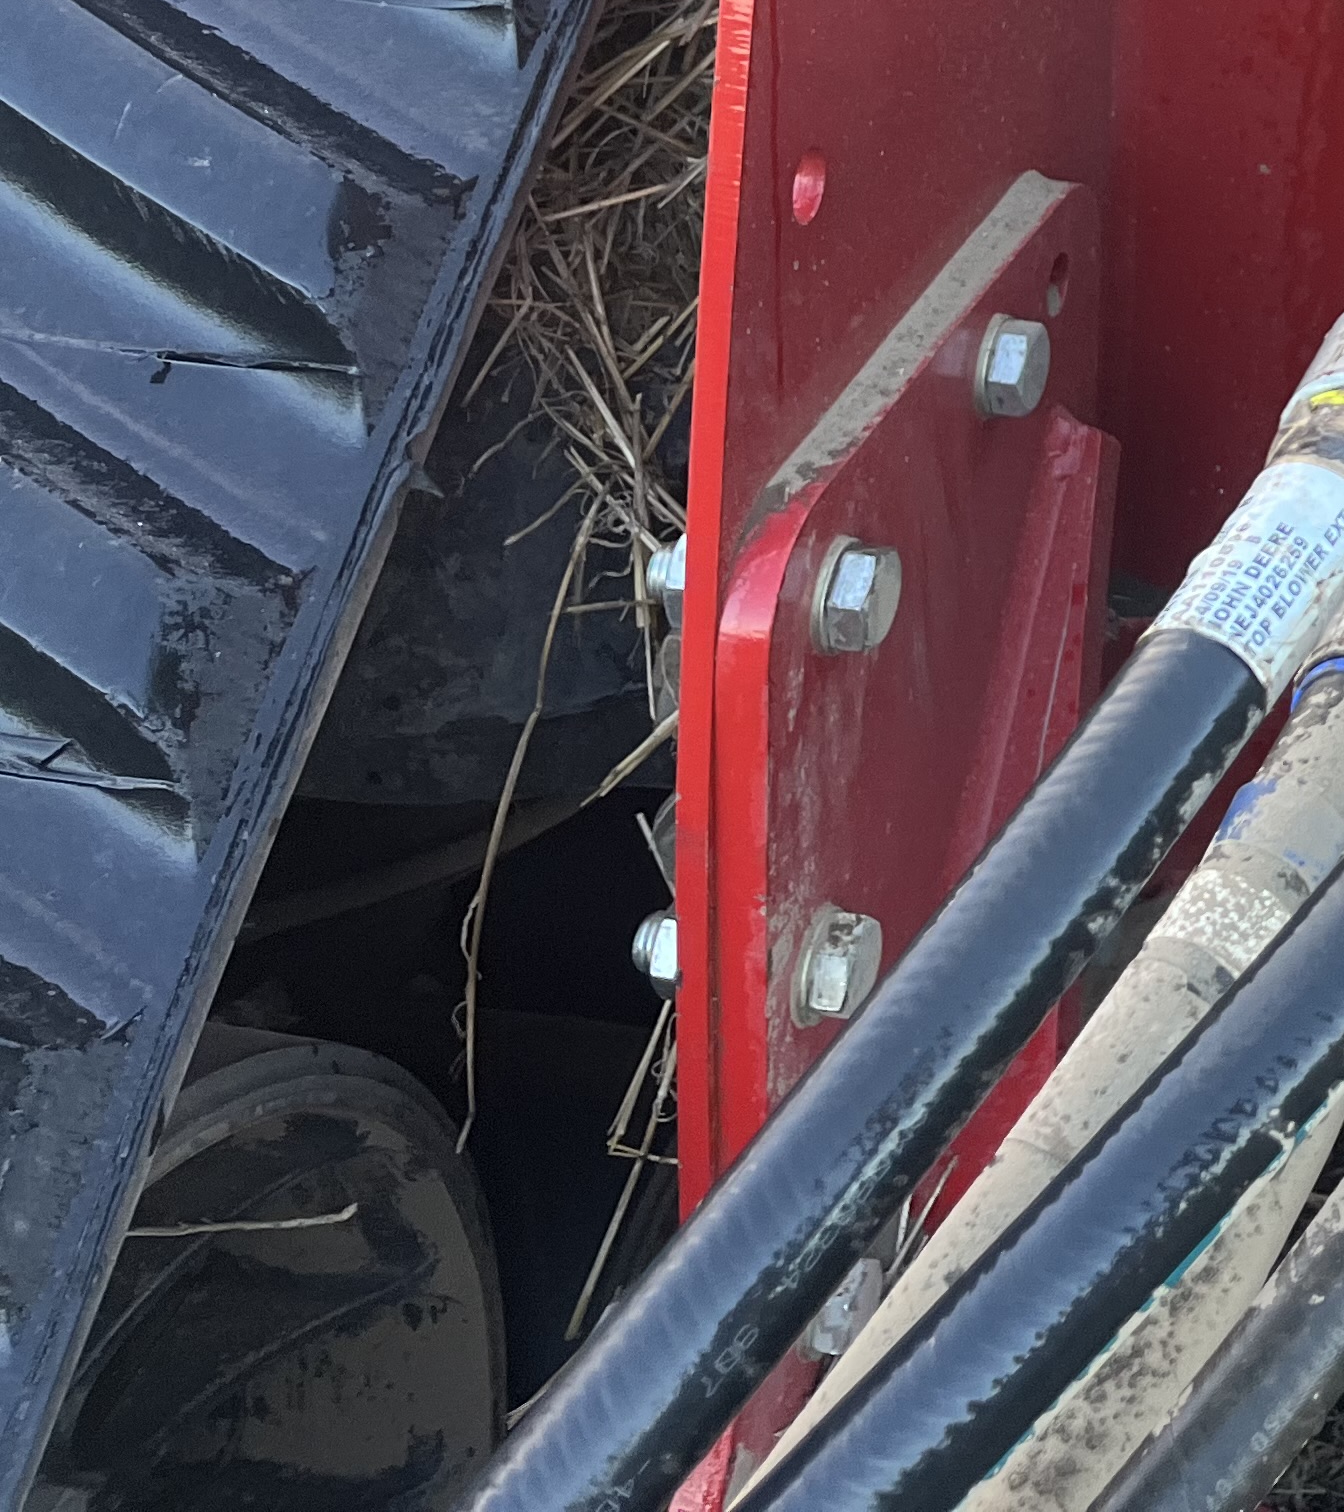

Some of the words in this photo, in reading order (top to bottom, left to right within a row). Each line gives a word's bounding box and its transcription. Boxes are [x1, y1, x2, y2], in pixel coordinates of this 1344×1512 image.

[1243, 518, 1295, 582] DEERE
[1241, 615, 1277, 657] TOP
[1268, 541, 1331, 619] BLOWER
